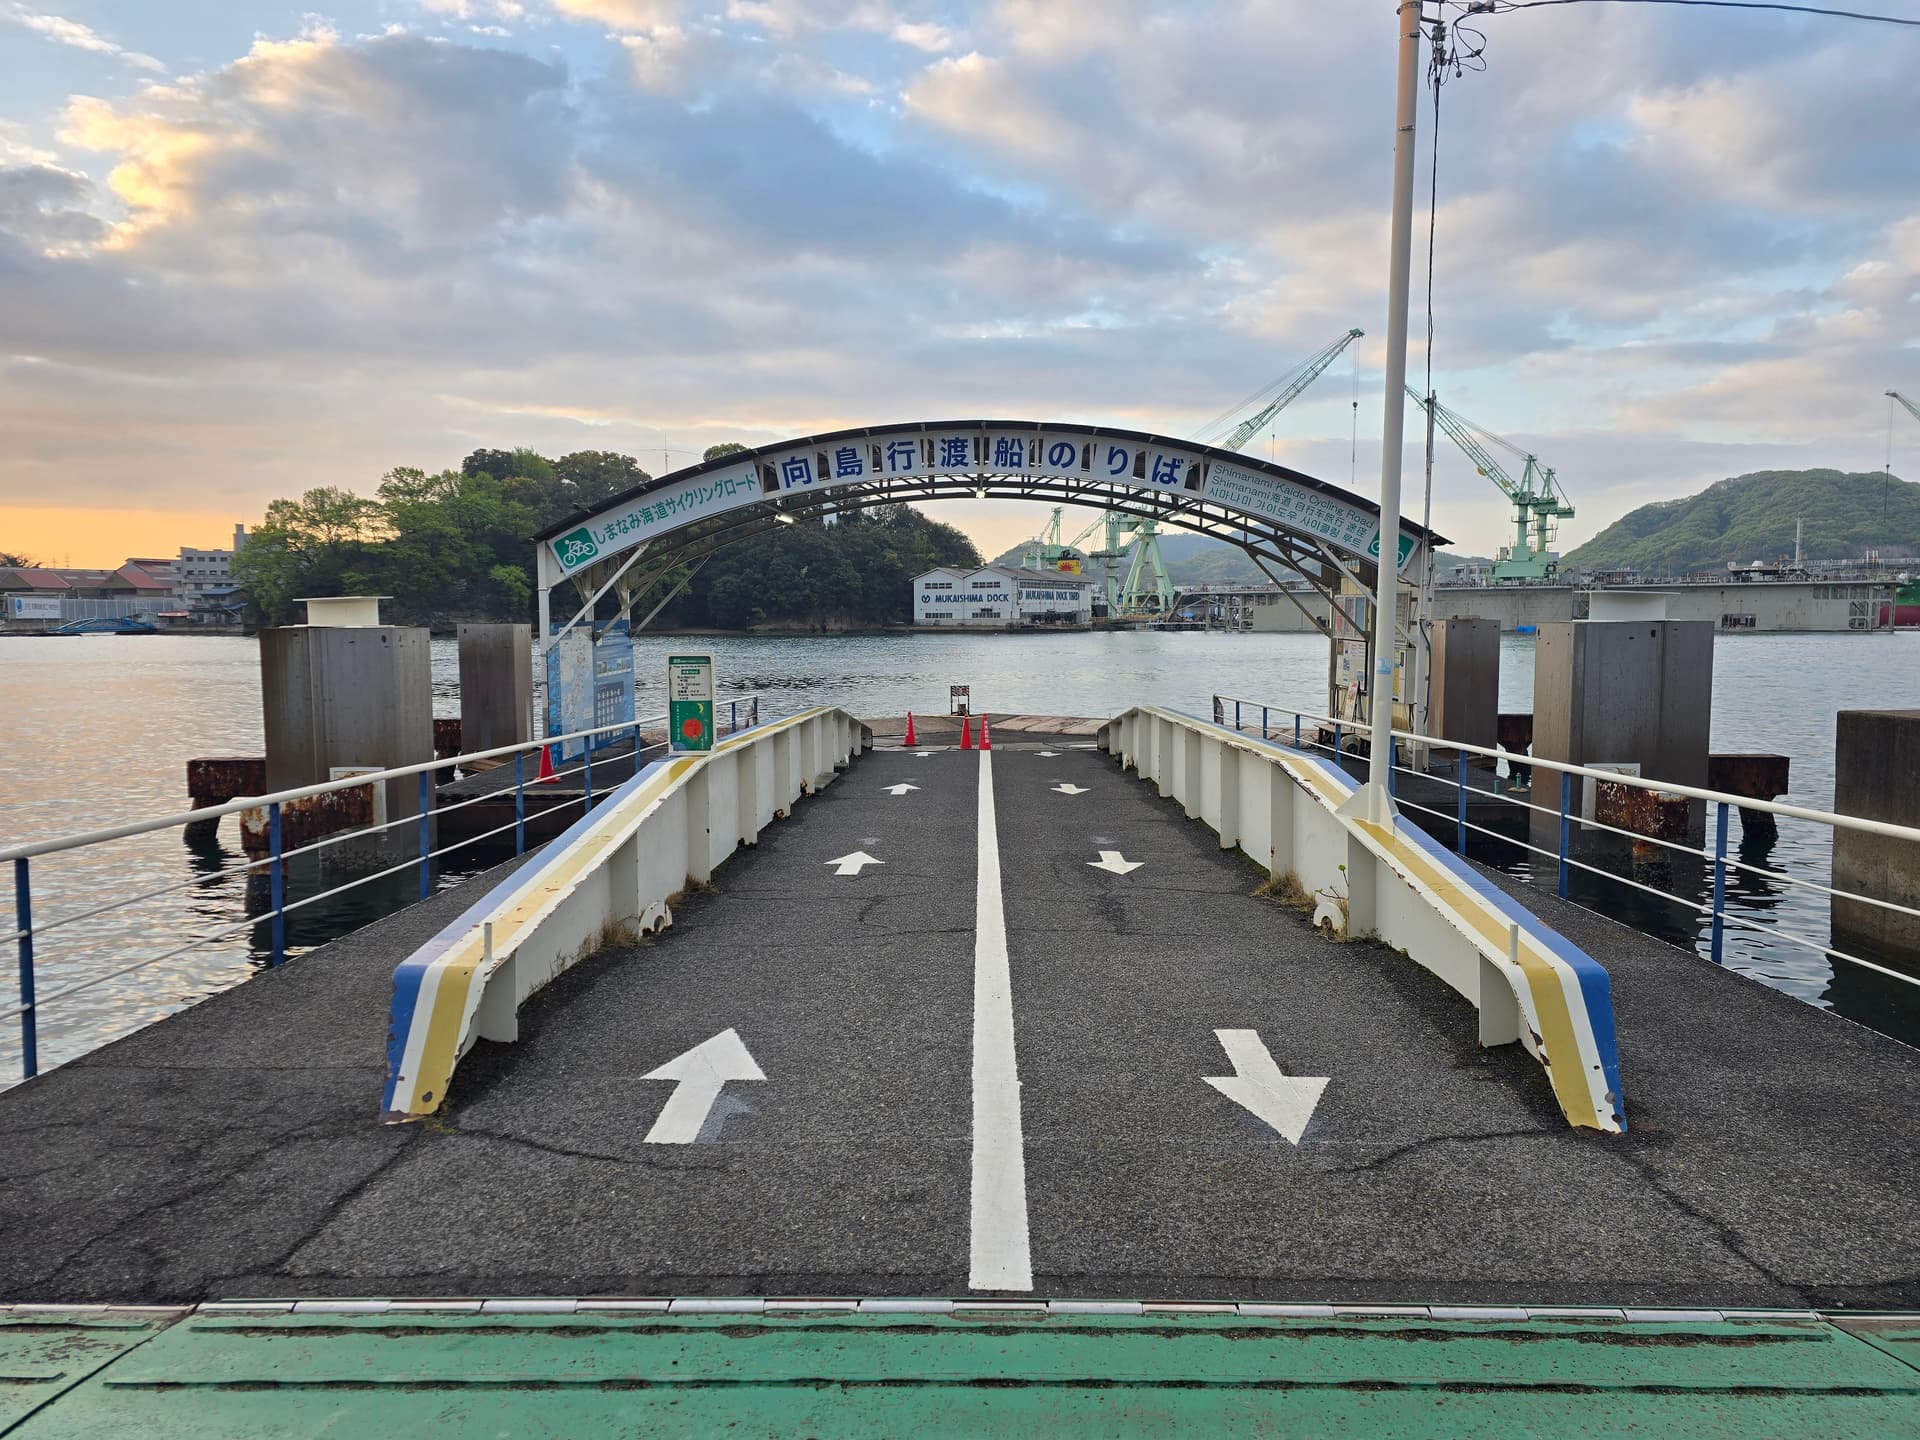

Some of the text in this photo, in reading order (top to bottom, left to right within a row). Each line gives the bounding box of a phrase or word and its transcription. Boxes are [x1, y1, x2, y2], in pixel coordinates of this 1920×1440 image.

[781, 436, 1185, 490] 向島行渡船のりば
[592, 472, 757, 545] しまなみ海道サイクリングロード
[1208, 487, 1251, 507] 시마나미
[1255, 500, 1298, 520] 가이도우
[1300, 516, 1341, 538] 사이클링
[1214, 464, 1376, 529] Shimanami Kaido Cycling Road
[935, 593, 1009, 603] MUKAISHIMA DOCK
[1055, 591, 1068, 601] DOCK
